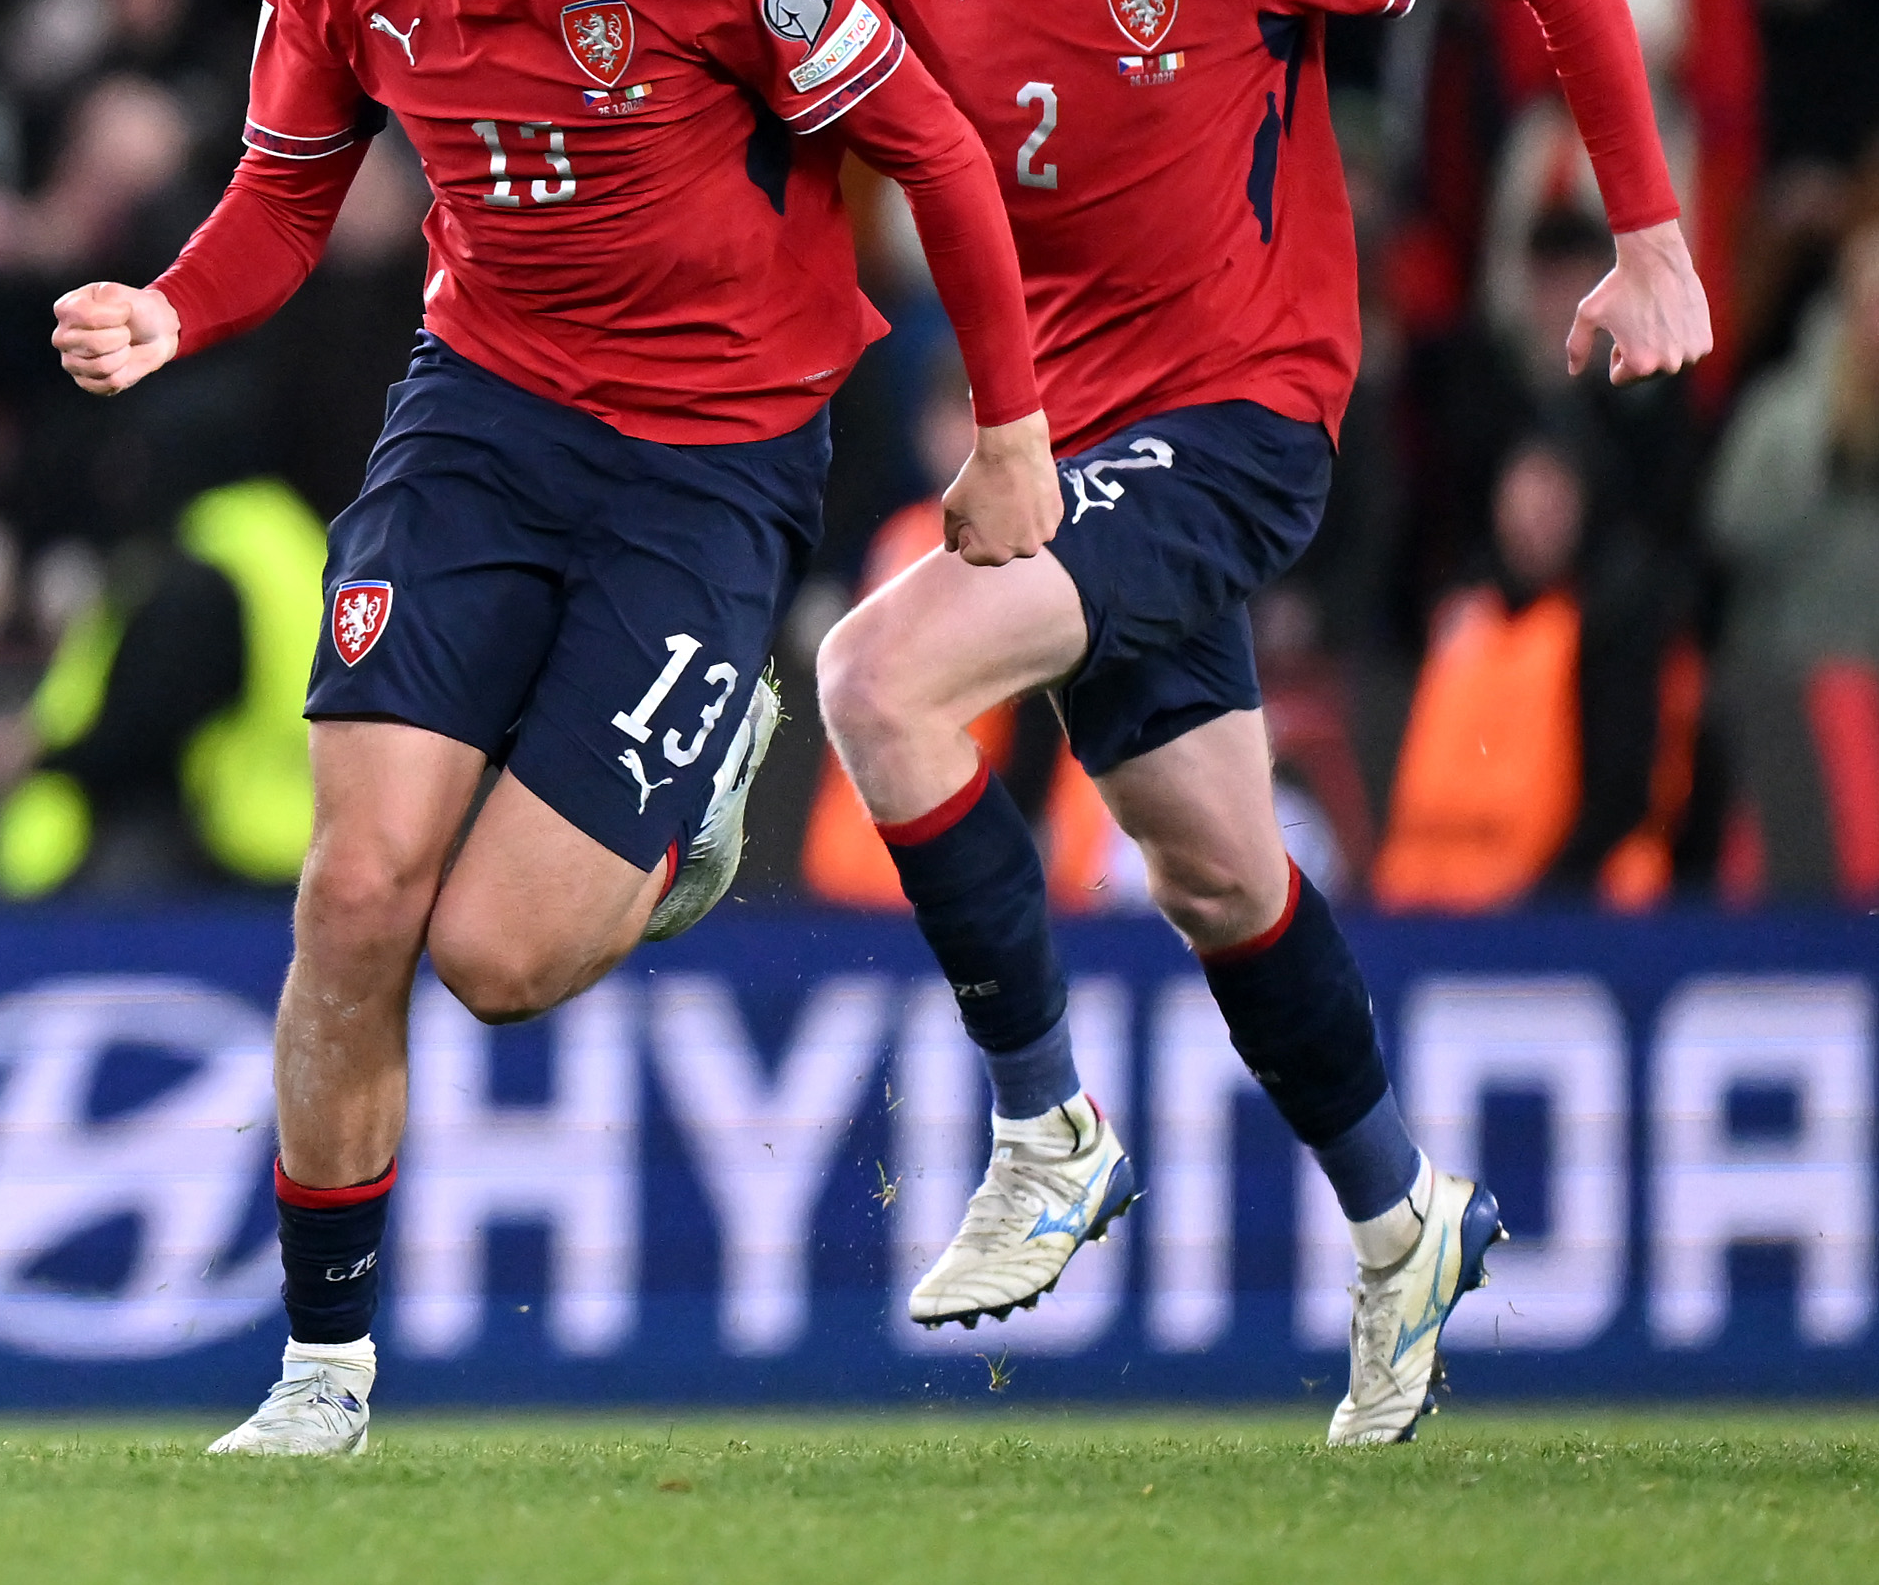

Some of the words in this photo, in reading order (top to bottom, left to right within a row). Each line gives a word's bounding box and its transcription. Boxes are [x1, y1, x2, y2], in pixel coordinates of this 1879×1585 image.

[796, 9, 873, 84] FOUNDATION
[471, 119, 577, 207] 13
[1016, 82, 1057, 189] 2
[1082, 437, 1176, 501] 2
[611, 633, 739, 768] 13
[951, 980, 1000, 997] ZE
[325, 1249, 377, 1281] CZE
